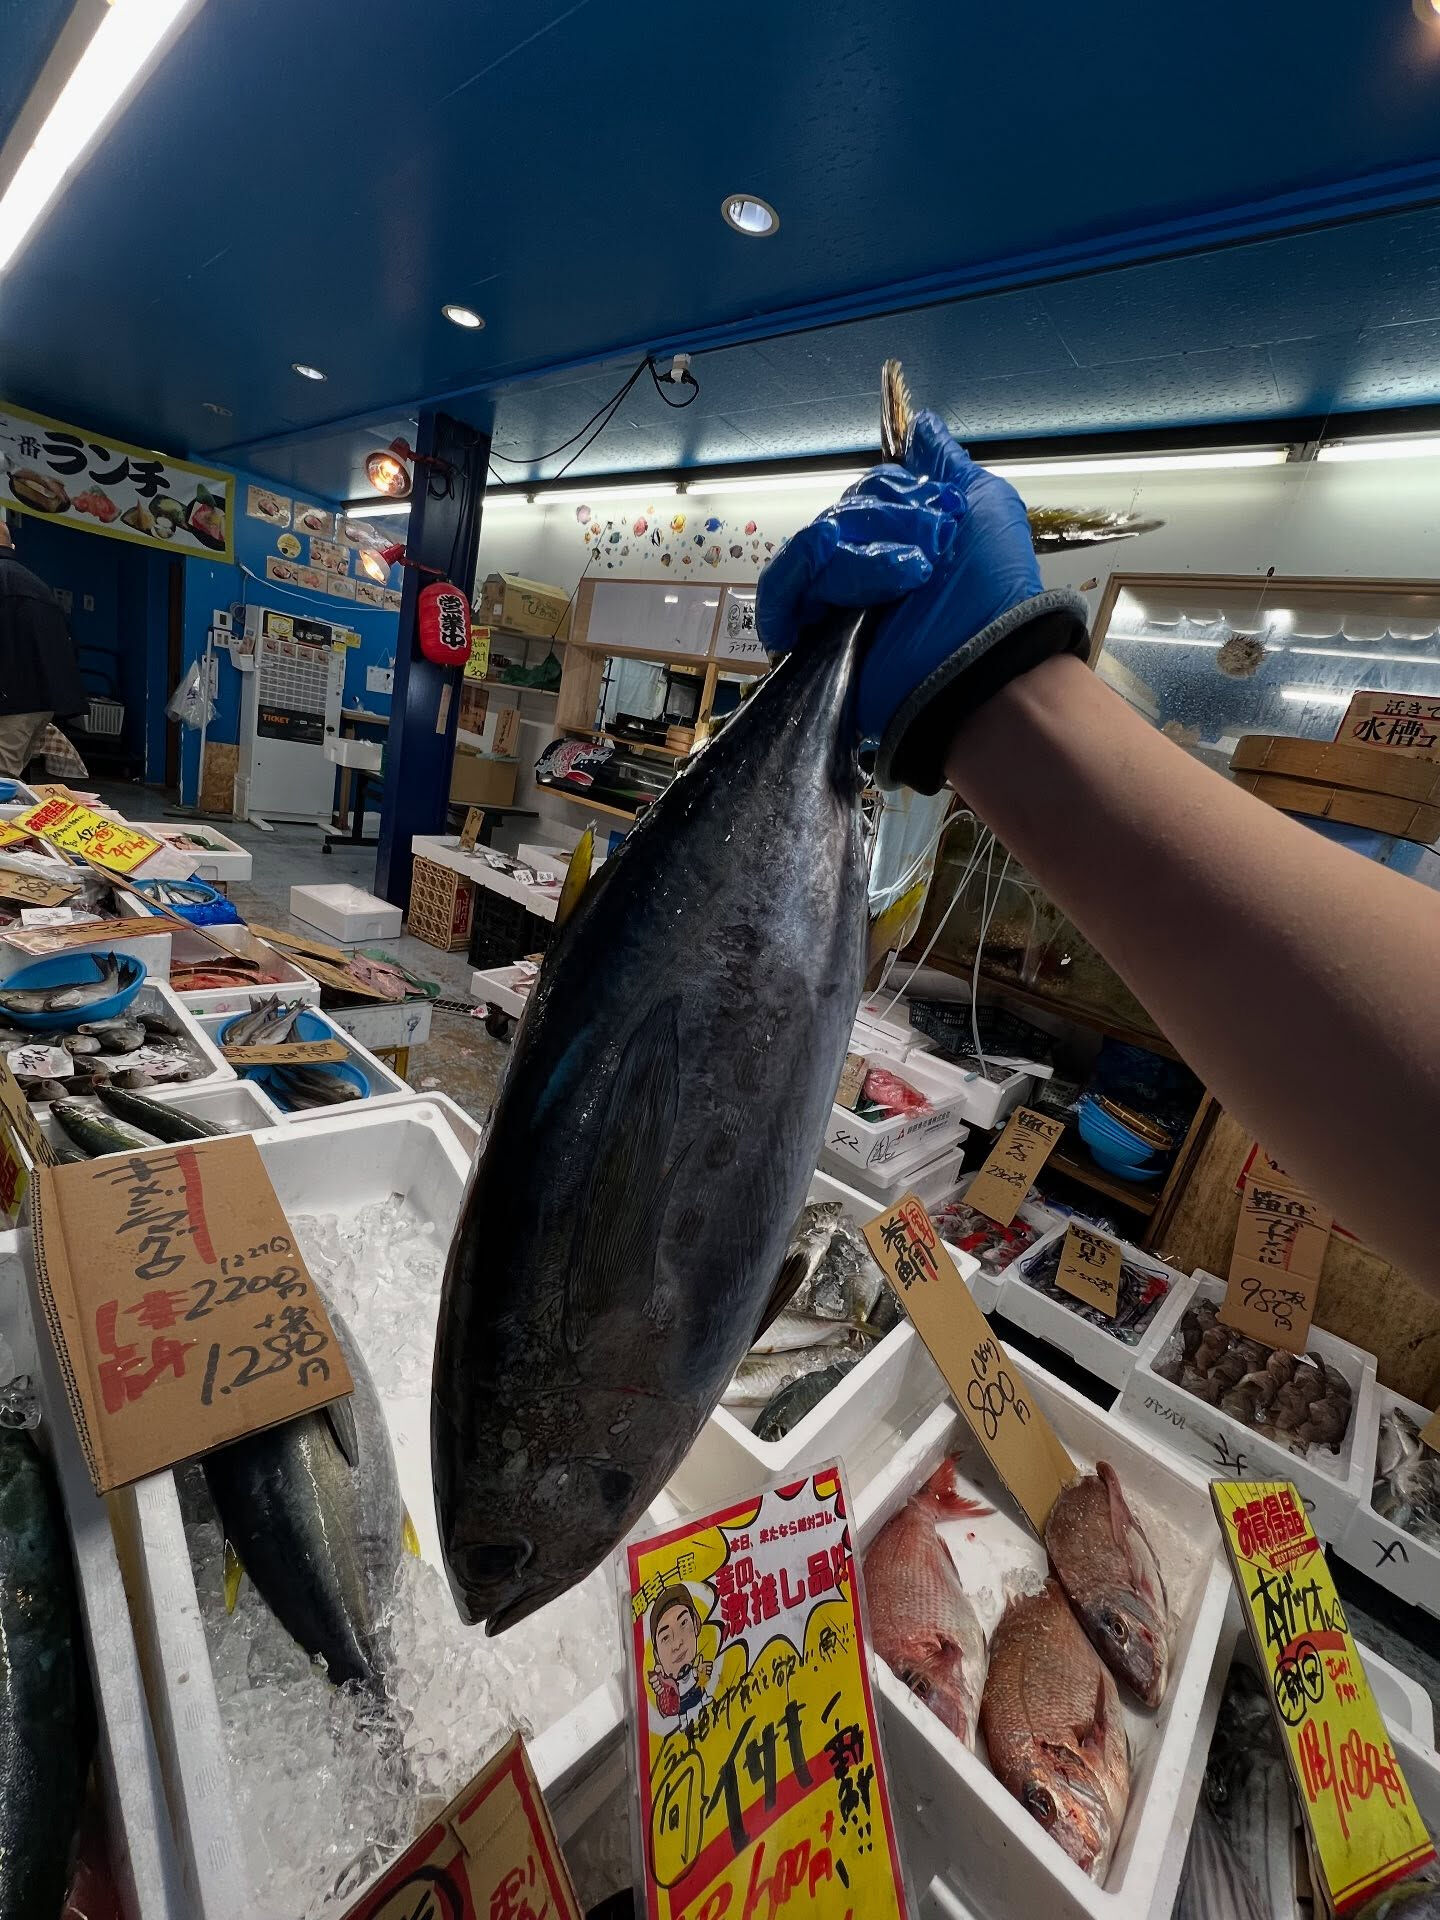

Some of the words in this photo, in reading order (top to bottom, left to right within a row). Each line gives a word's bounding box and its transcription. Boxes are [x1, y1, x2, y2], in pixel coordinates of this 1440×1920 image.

[437, 593, 469, 651] 営業中
[262, 712, 291, 726] TICKET
[1232, 1489, 1307, 1560] お買得品
